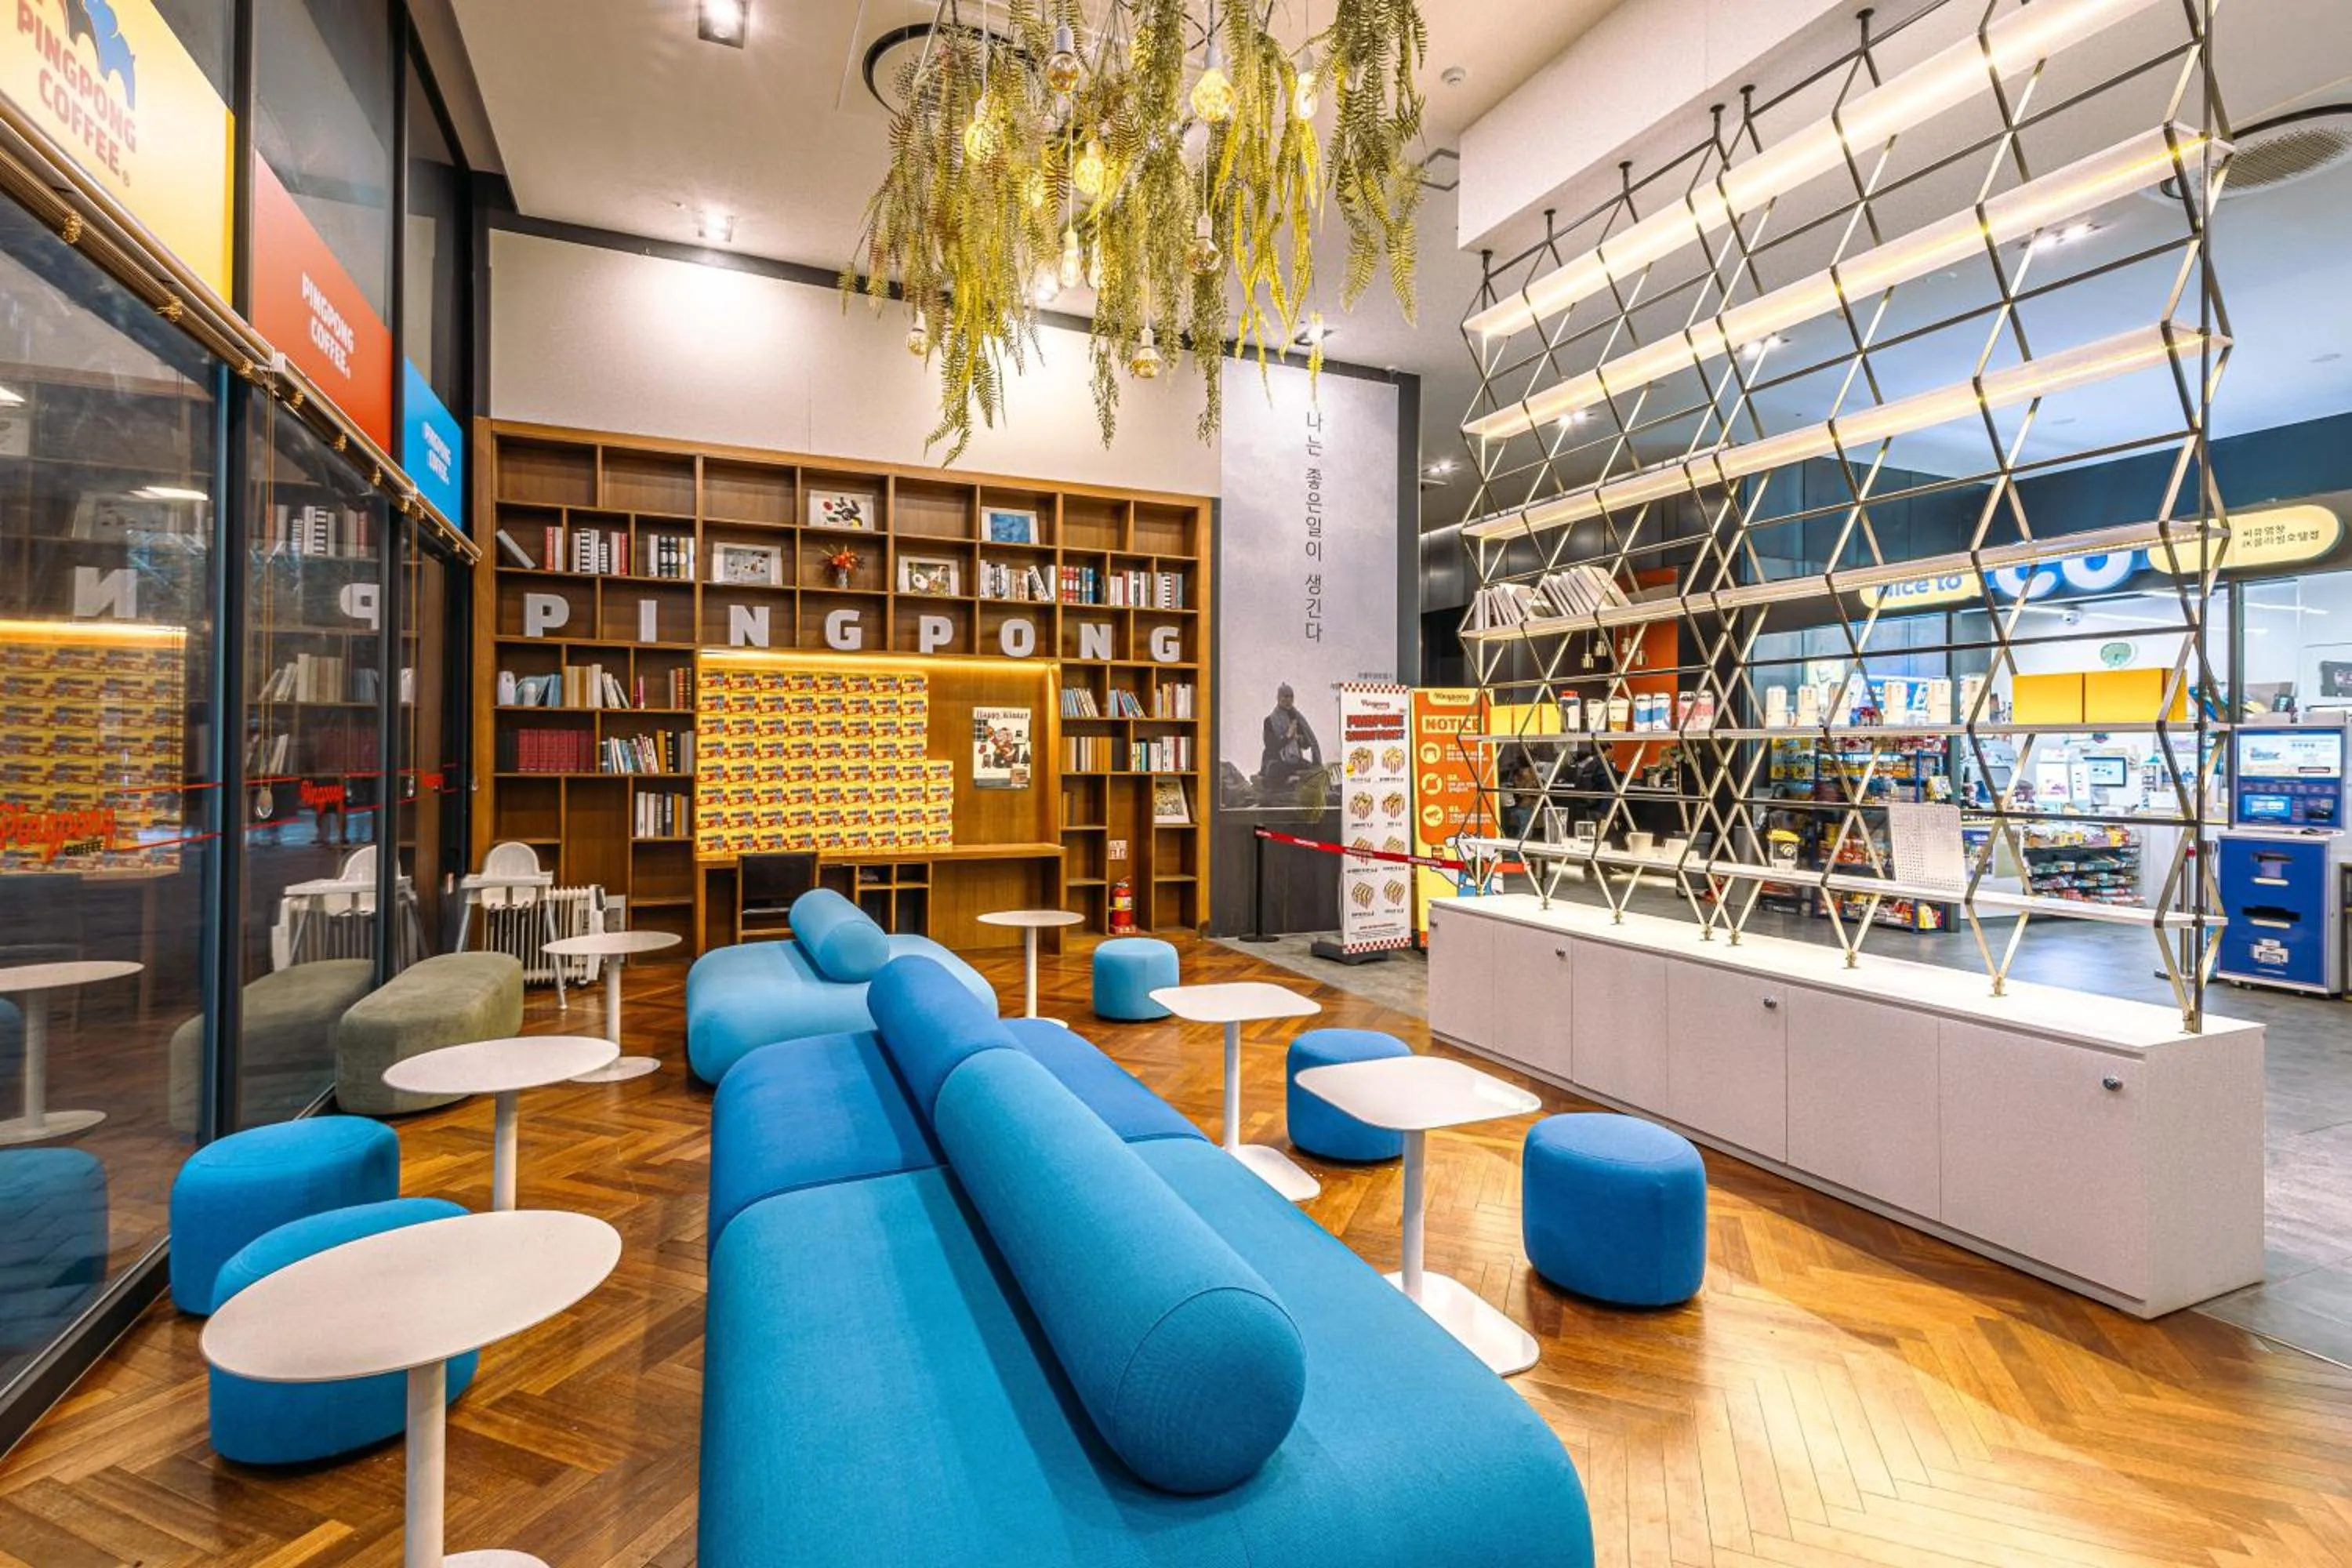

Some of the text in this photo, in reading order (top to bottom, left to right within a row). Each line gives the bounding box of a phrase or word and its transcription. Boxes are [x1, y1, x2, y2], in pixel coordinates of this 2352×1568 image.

[16, 0, 136, 154] PINGPONG
[38, 67, 120, 176] COFFEE
[302, 270, 354, 354] PINGPONG
[310, 315, 347, 374] COFFEE
[1305, 412, 1324, 457] 나는
[1305, 573, 1324, 644] 생긴다
[1425, 718, 1480, 731] NOTICE
[65, 840, 103, 857] COFFEE
